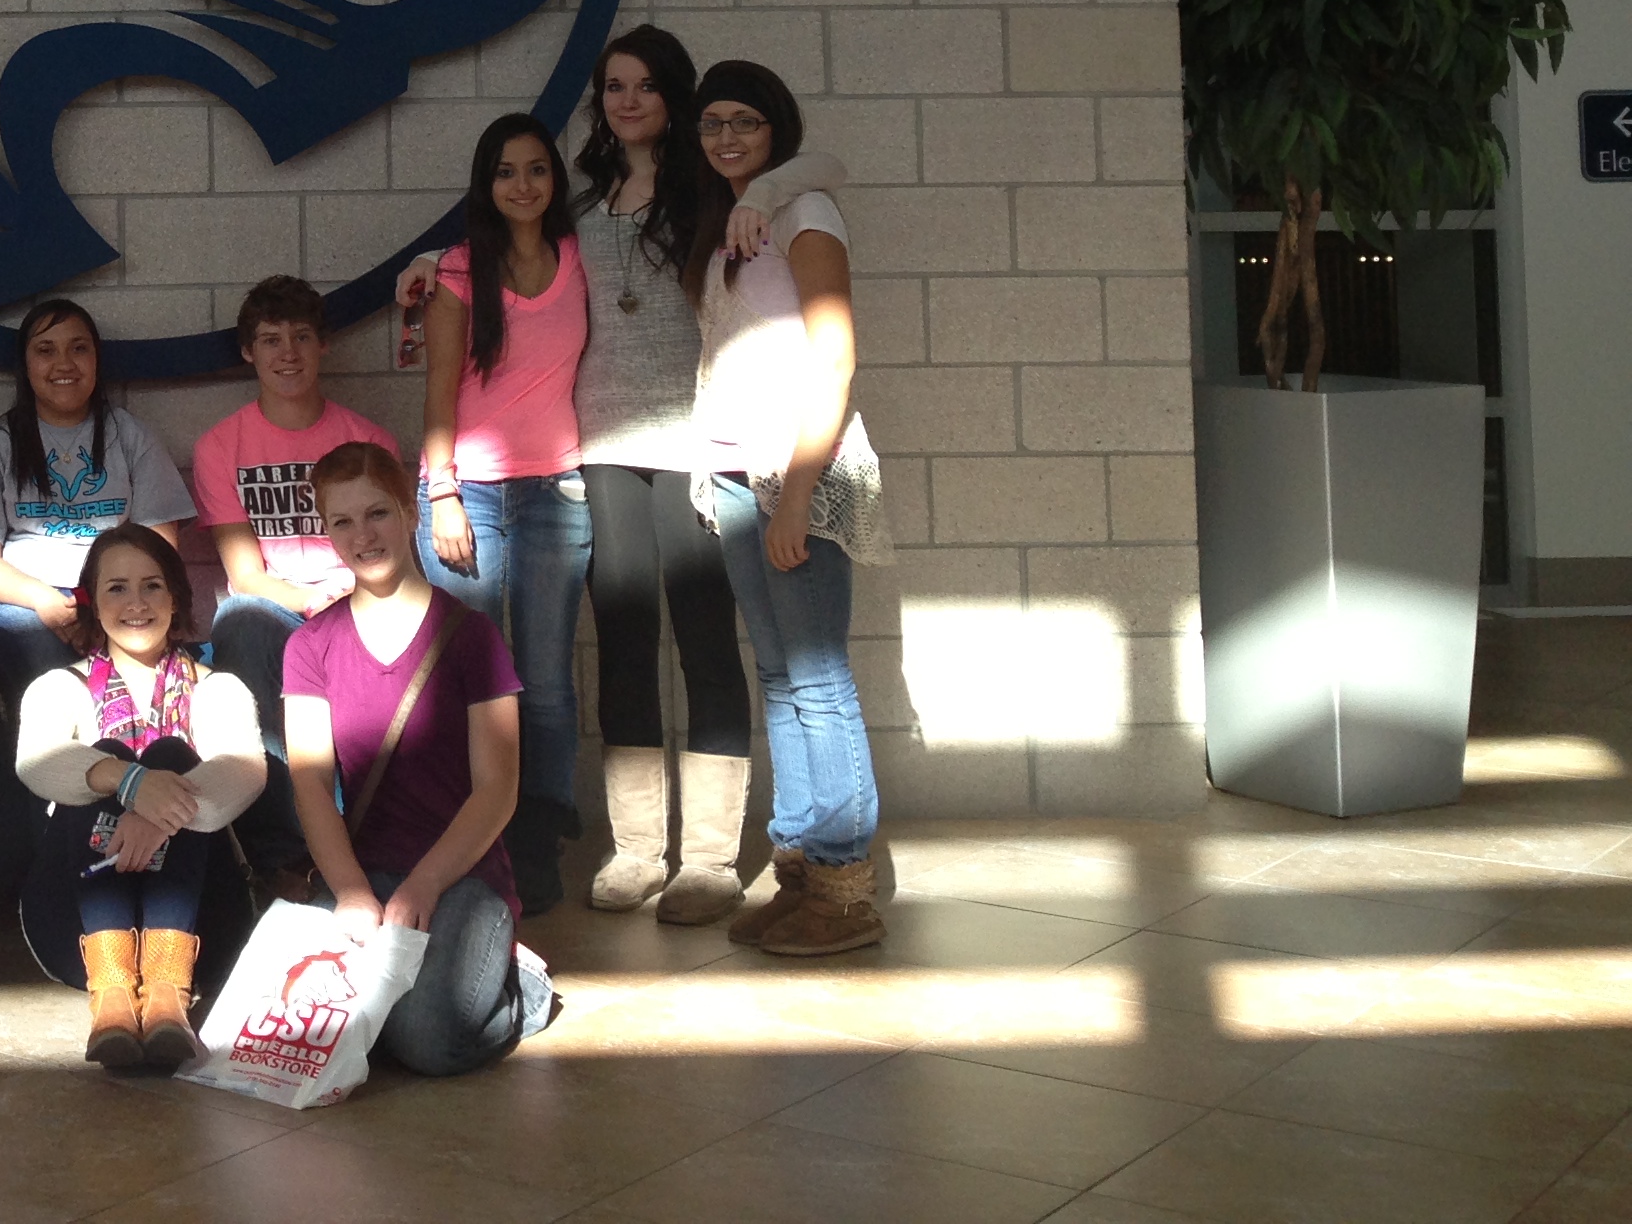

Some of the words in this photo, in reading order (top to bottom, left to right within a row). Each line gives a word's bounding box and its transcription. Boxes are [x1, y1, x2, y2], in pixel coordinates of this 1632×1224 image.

[15, 498, 127, 520] REALTREE
[243, 484, 314, 515] ADVIS
[247, 998, 347, 1048] CSU
[229, 1051, 324, 1080] BOOKSTORE
[235, 1036, 328, 1066] PUEBLO
